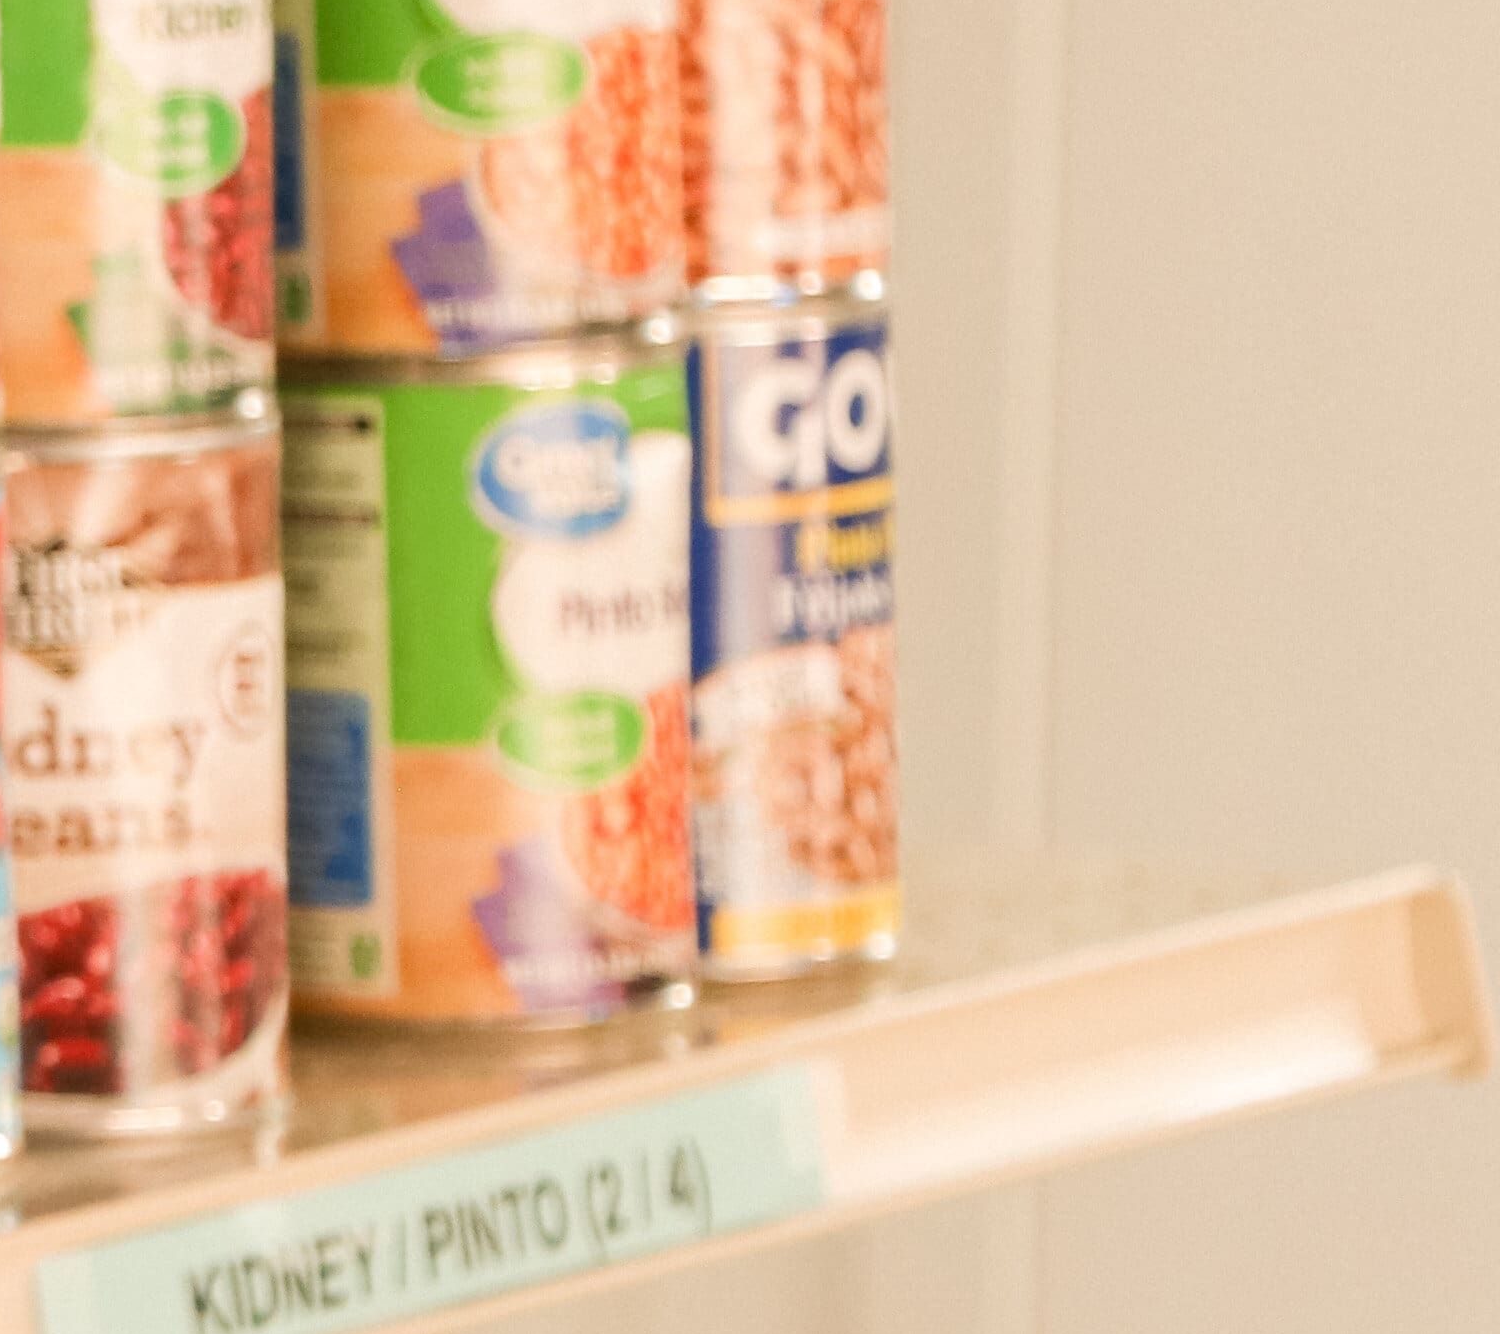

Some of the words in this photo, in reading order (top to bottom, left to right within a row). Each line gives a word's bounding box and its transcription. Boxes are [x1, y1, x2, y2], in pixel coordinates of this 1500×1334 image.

[395, 1218, 409, 1287] /
[422, 1177, 568, 1283] PINTO
[584, 1163, 626, 1260] (2
[641, 1152, 655, 1222] /
[664, 1137, 713, 1239] 4)
